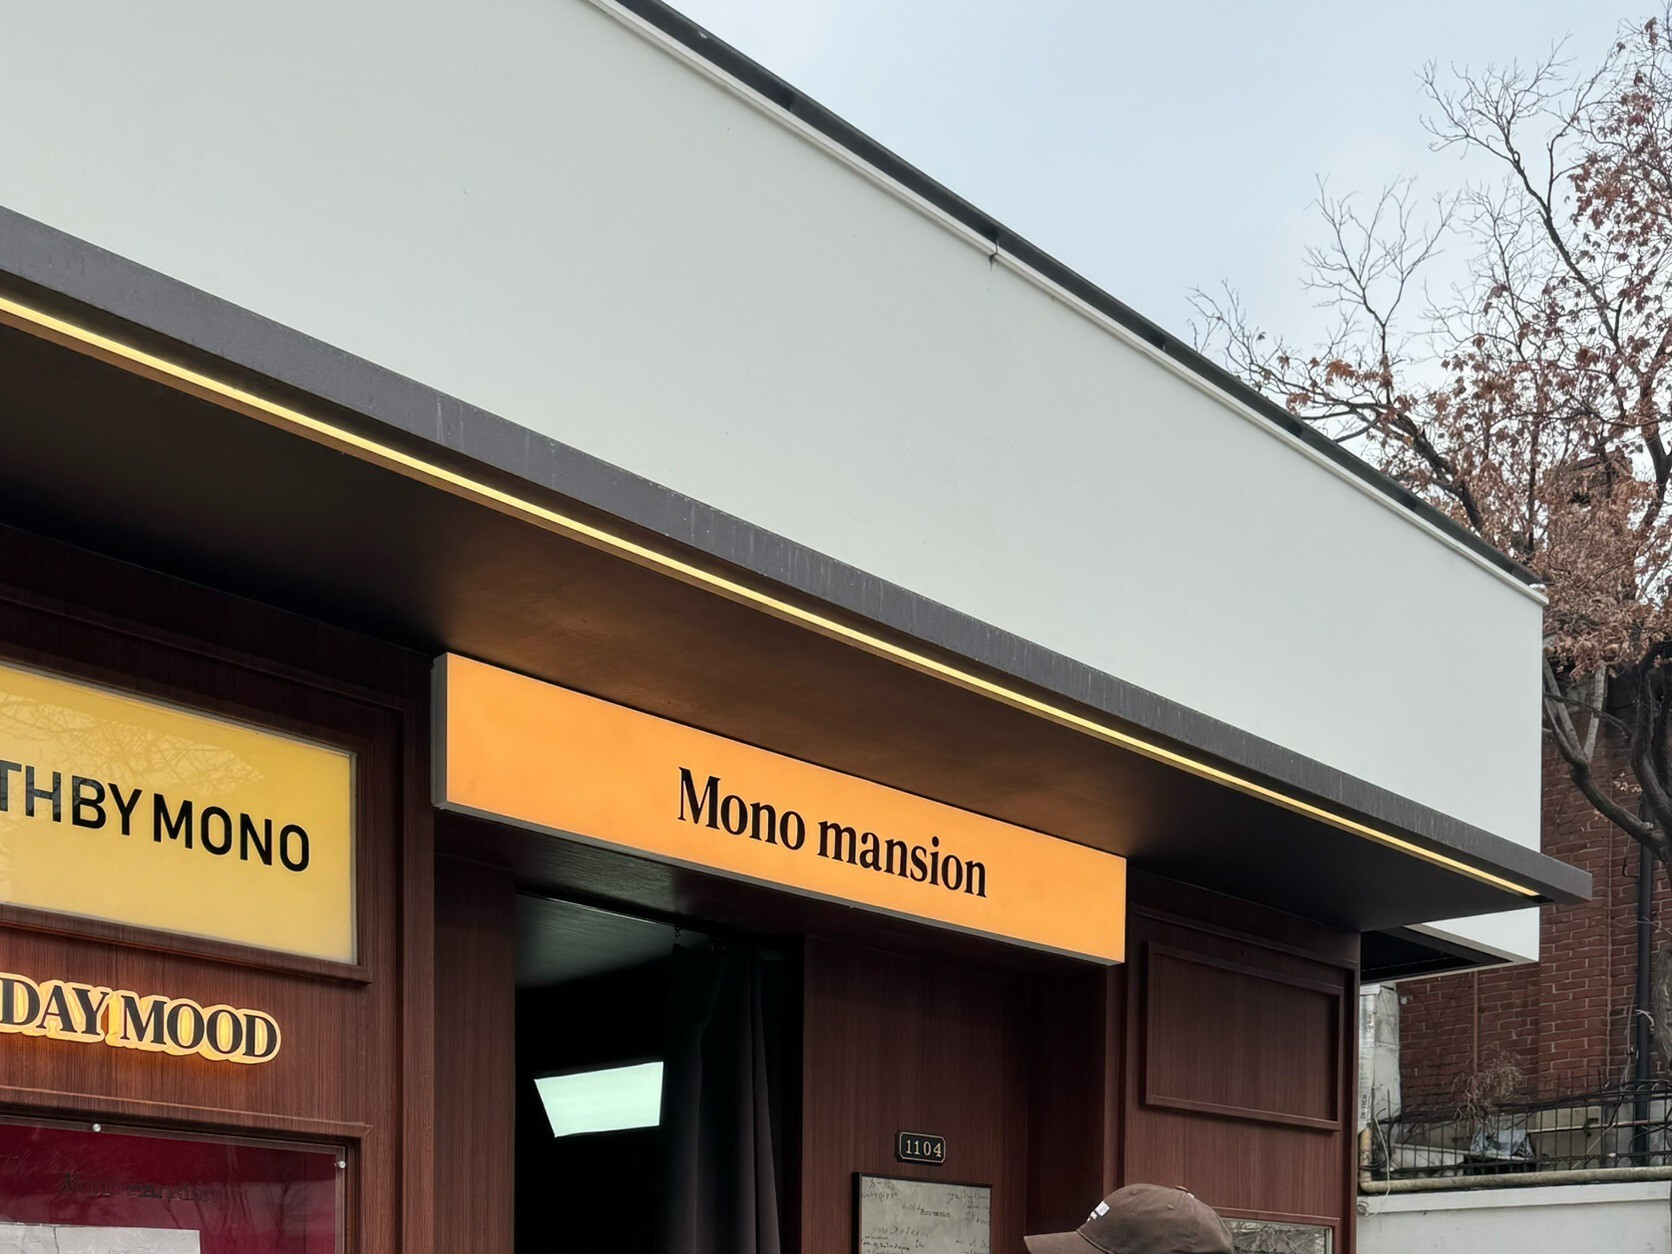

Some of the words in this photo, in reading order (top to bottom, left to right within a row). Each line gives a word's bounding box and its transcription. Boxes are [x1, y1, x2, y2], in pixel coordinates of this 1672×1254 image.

[677, 766, 806, 851] Mono
[816, 820, 987, 898] mansion
[905, 1139, 942, 1158] 1104
